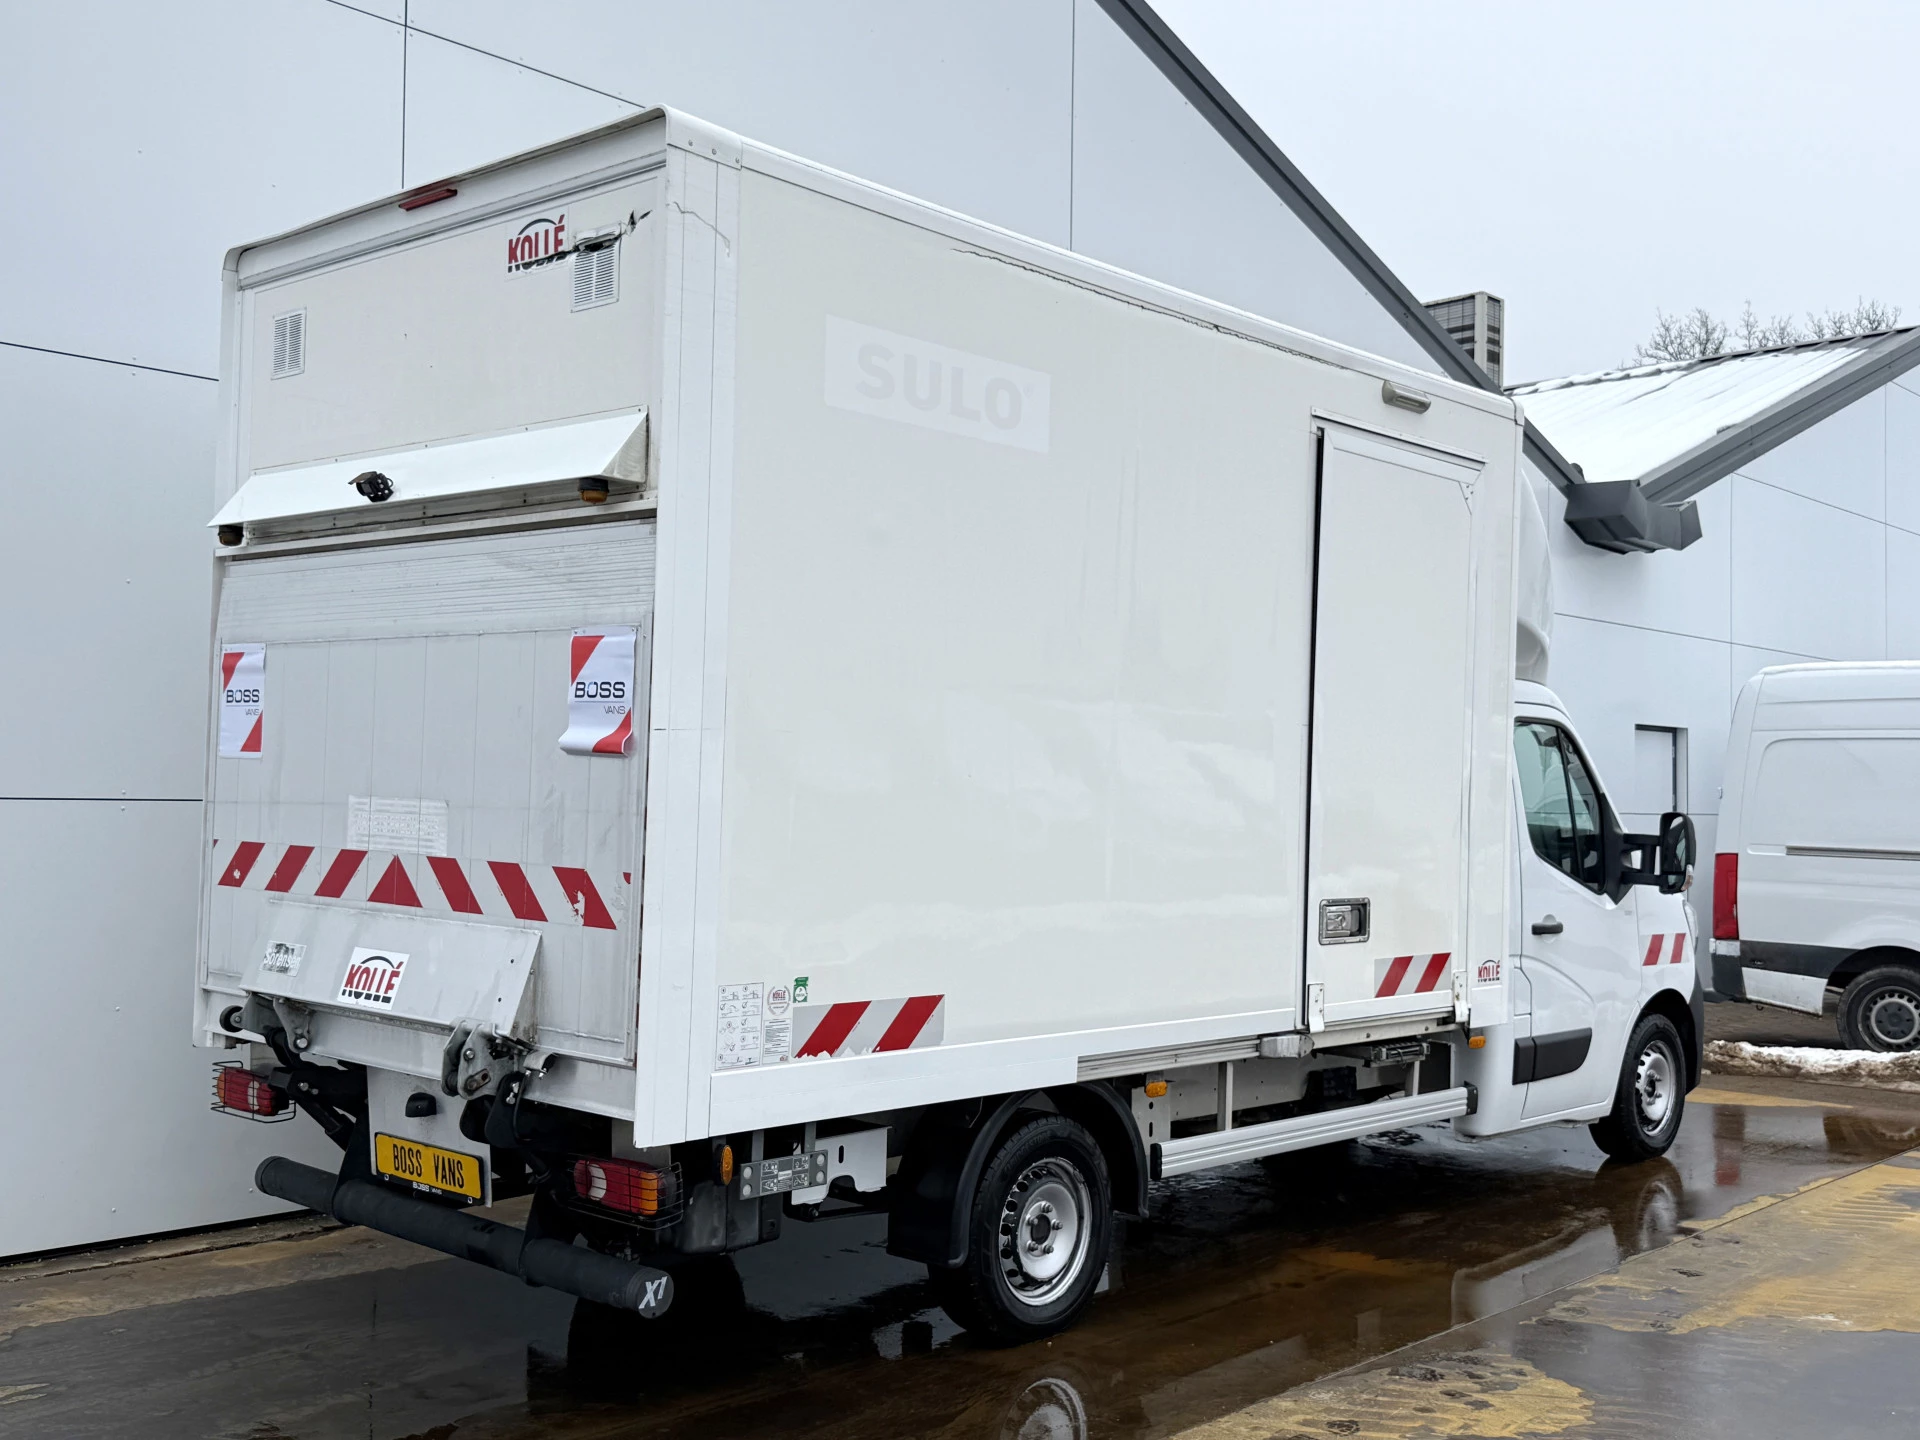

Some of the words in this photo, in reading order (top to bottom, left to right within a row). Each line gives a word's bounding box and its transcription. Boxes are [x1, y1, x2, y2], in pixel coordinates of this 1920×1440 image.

[855, 343, 1023, 430] SULO
[226, 689, 260, 703] BOSS
[574, 681, 626, 699] BOSS
[603, 705, 626, 715] VANS
[341, 961, 404, 1004] KOLLÉ
[1477, 959, 1501, 983] KOLLÉ
[392, 1143, 423, 1178] BOSS
[433, 1153, 464, 1189] VANS
[638, 1275, 668, 1309] X1
